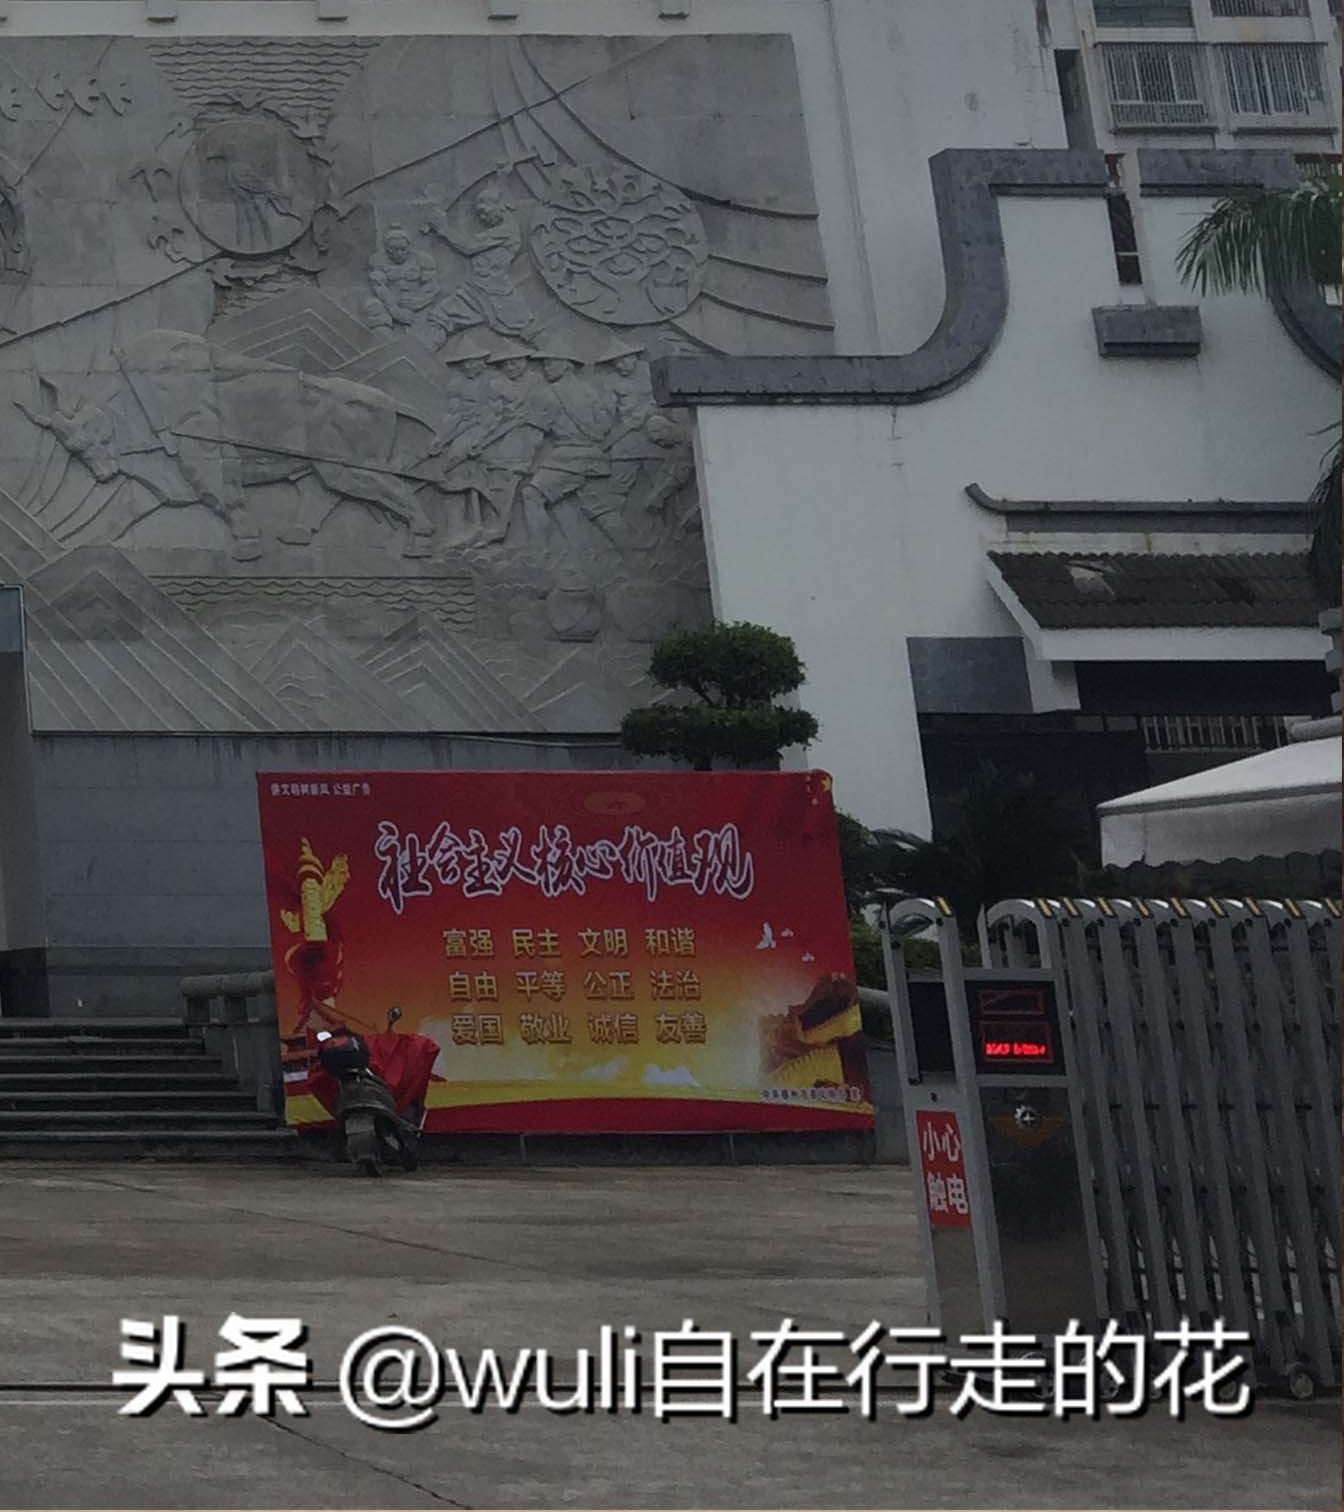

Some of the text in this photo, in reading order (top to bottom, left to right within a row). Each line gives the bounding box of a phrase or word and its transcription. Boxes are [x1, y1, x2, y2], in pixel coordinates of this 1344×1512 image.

[373, 820, 754, 915] 社会主义核心价值观
[442, 926, 697, 959] 富强 民主 文明 和谐
[448, 969, 702, 1002] 自由 平等 公正 法治
[450, 1011, 708, 1046] 爱国 敬业 诚信 友善
[922, 1120, 961, 1163] 小心
[926, 1170, 969, 1215] 触电
